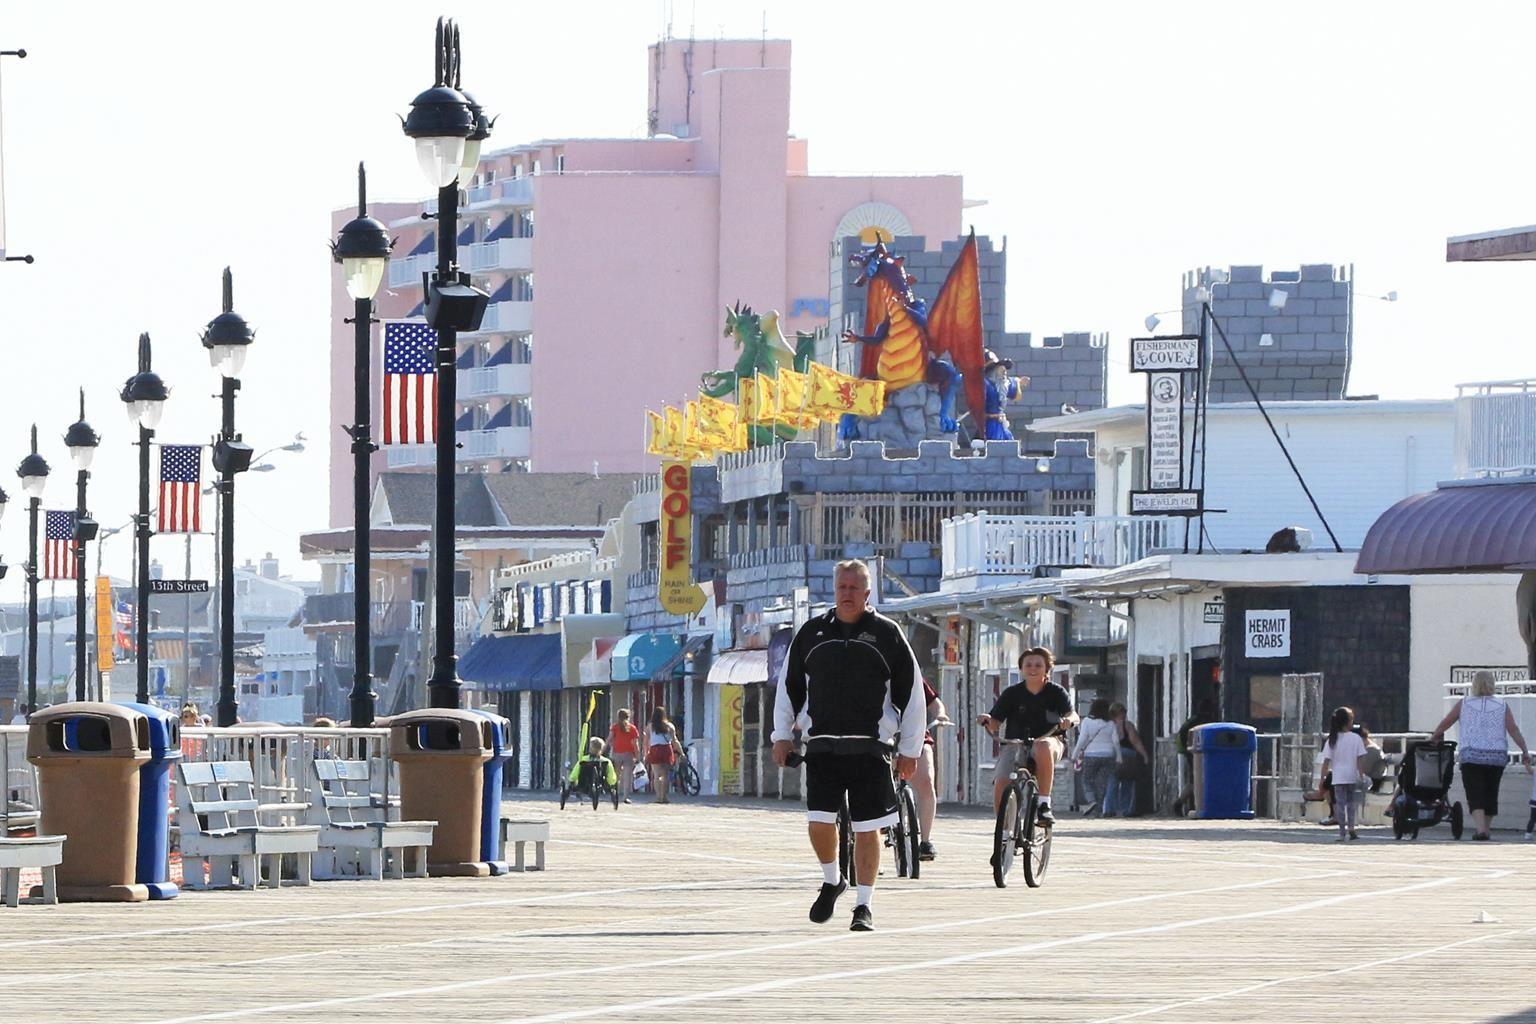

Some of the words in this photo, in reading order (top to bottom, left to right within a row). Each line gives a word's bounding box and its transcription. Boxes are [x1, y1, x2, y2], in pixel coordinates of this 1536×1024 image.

[1136, 341, 1197, 351] FISHERMAN'S
[1149, 351, 1184, 363] COVE
[1135, 498, 1149, 506] THE
[1151, 498, 1179, 506] JEWELRY
[1182, 496, 1196, 505] HUT
[664, 465, 689, 570] GOLF
[151, 581, 174, 591] 13th
[176, 581, 207, 591] Street
[1205, 604, 1224, 614] ATM
[1249, 618, 1287, 634] HERMIT
[1251, 634, 1284, 648] CRABS
